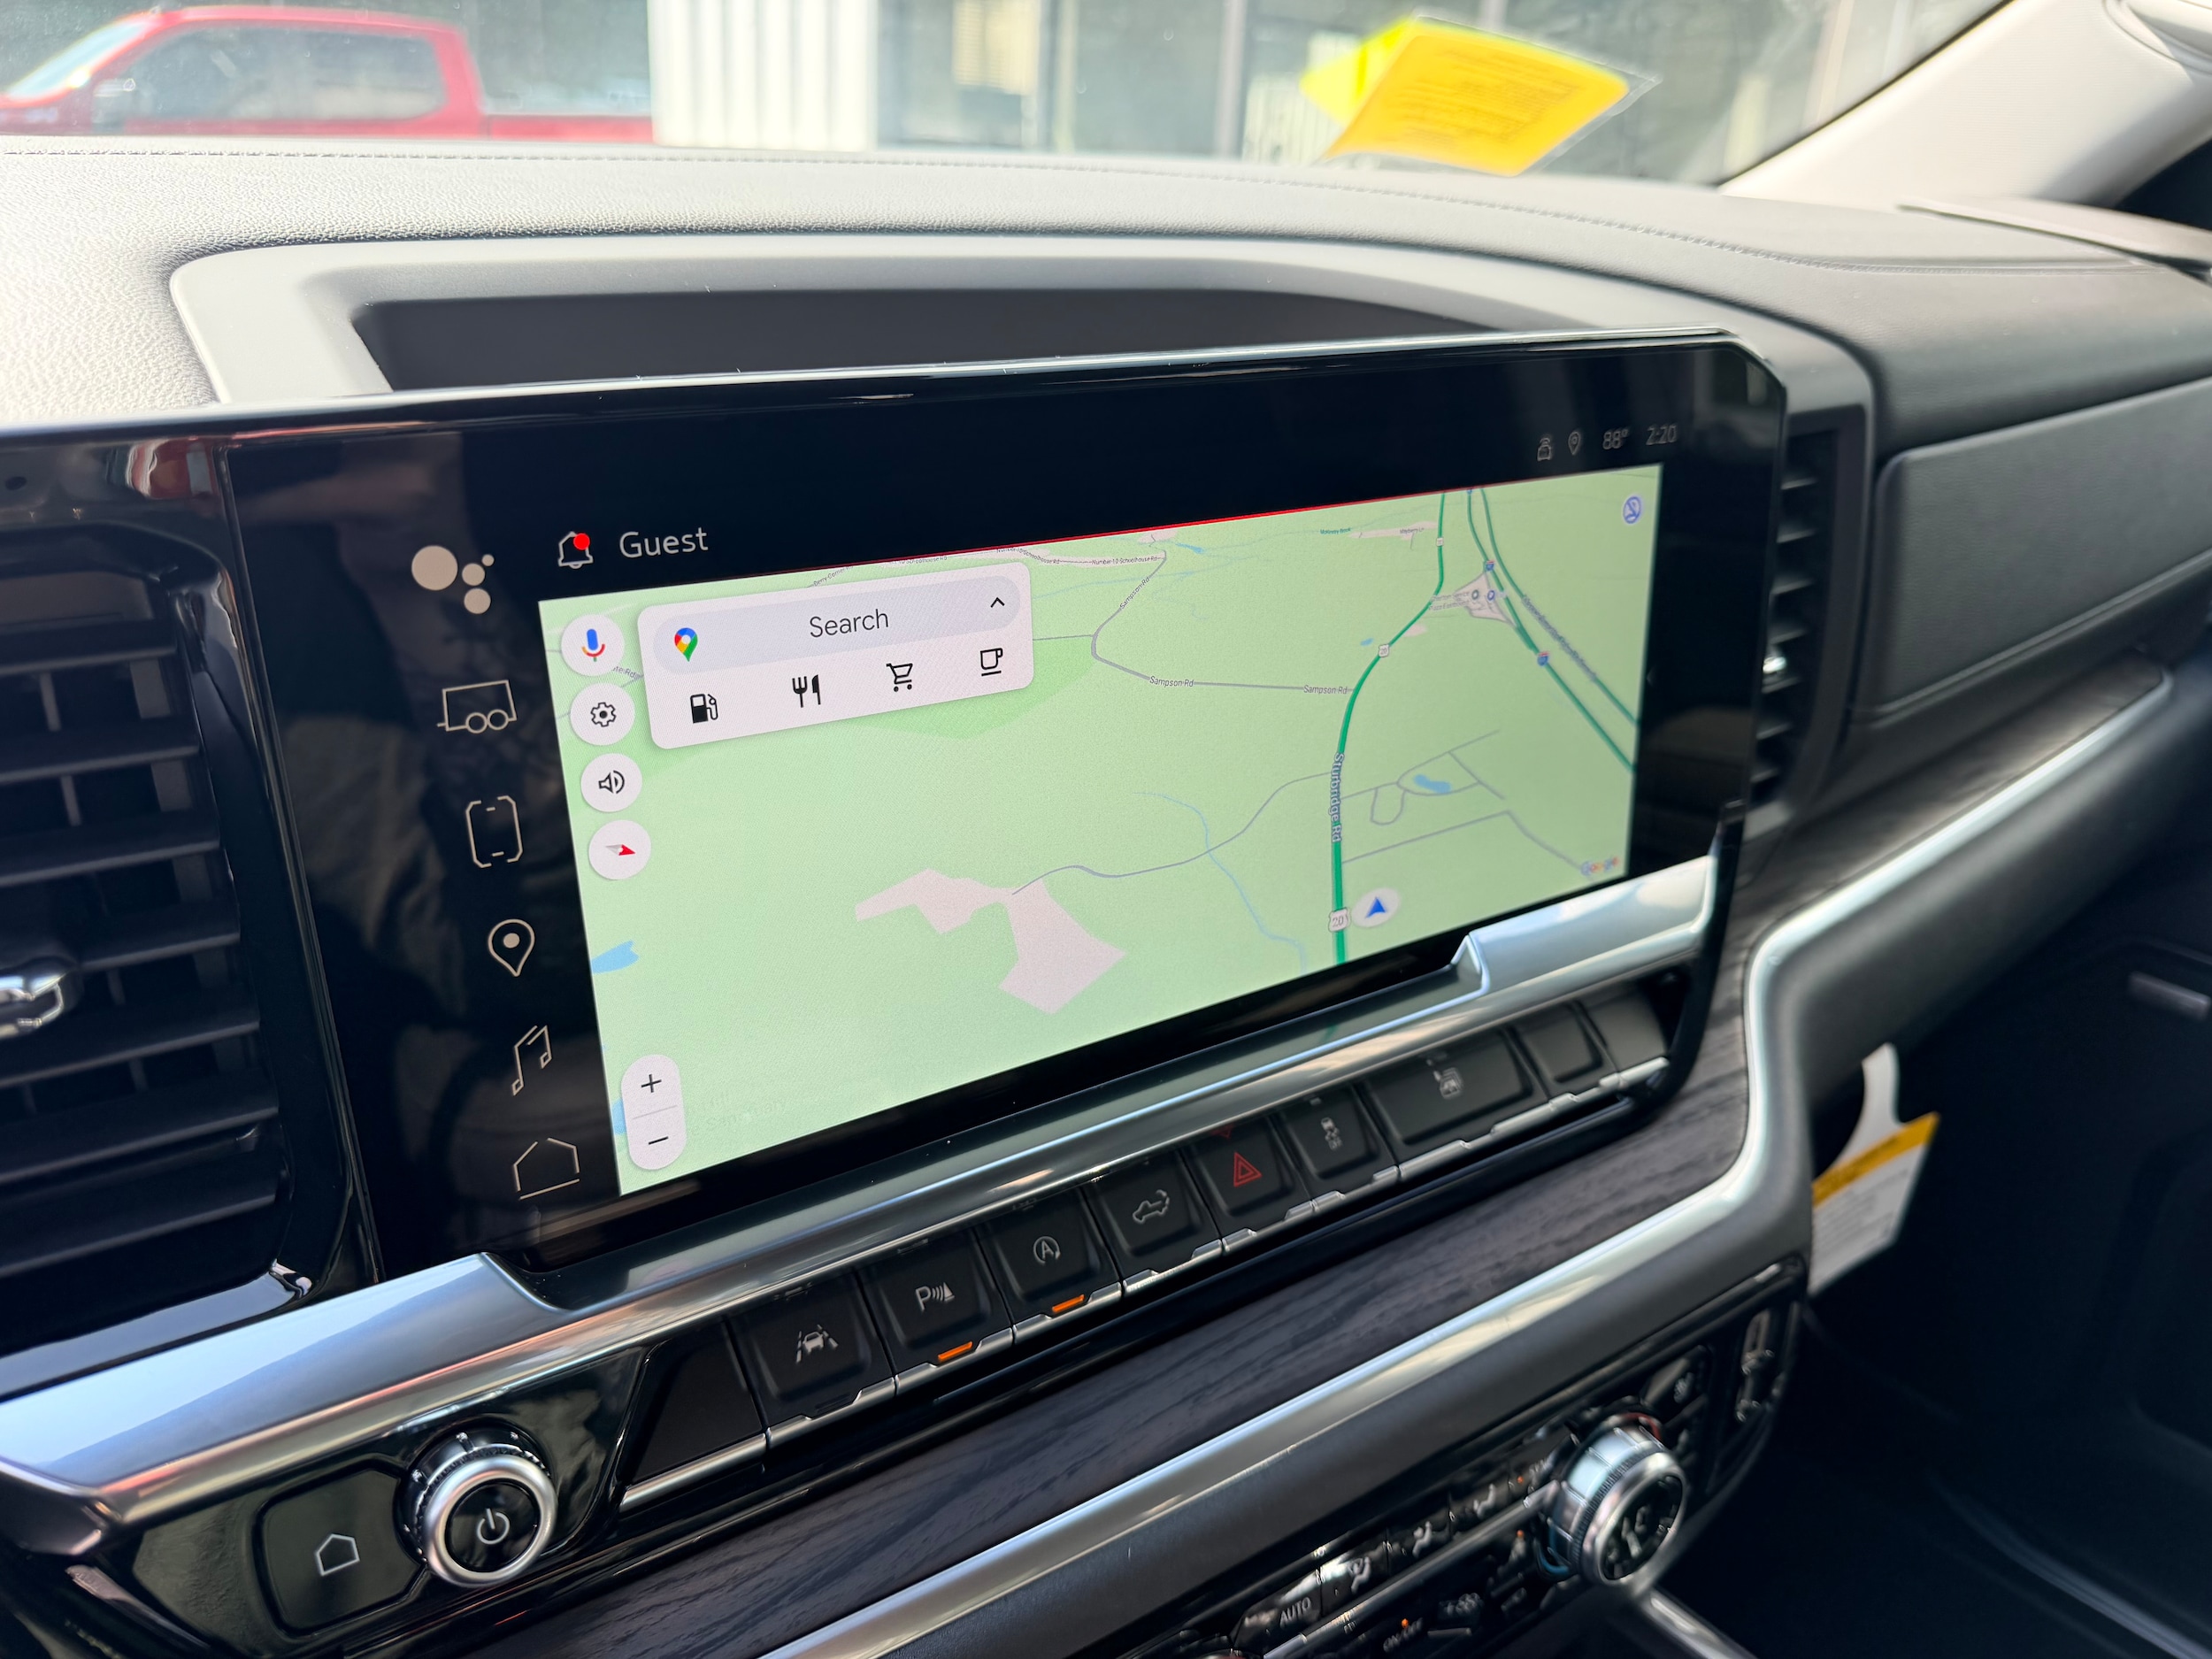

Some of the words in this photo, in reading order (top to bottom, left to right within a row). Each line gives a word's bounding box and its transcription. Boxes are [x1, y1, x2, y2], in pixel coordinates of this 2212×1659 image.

[1646, 424, 1678, 446] 2:20
[619, 527, 709, 559] Guest
[1119, 582, 1142, 610] Sampson
[1141, 576, 1151, 588] Rd
[809, 608, 889, 639] Search
[1149, 676, 1184, 688] Sampson
[1184, 679, 1194, 687] Rd
[1303, 684, 1336, 695] Sampson
[1337, 686, 1348, 695] Rd
[1328, 752, 1344, 823] Sturbridge
[1332, 824, 1342, 842] Rd
[1332, 915, 1344, 928] 20
[1279, 1596, 1312, 1628] AUTO
